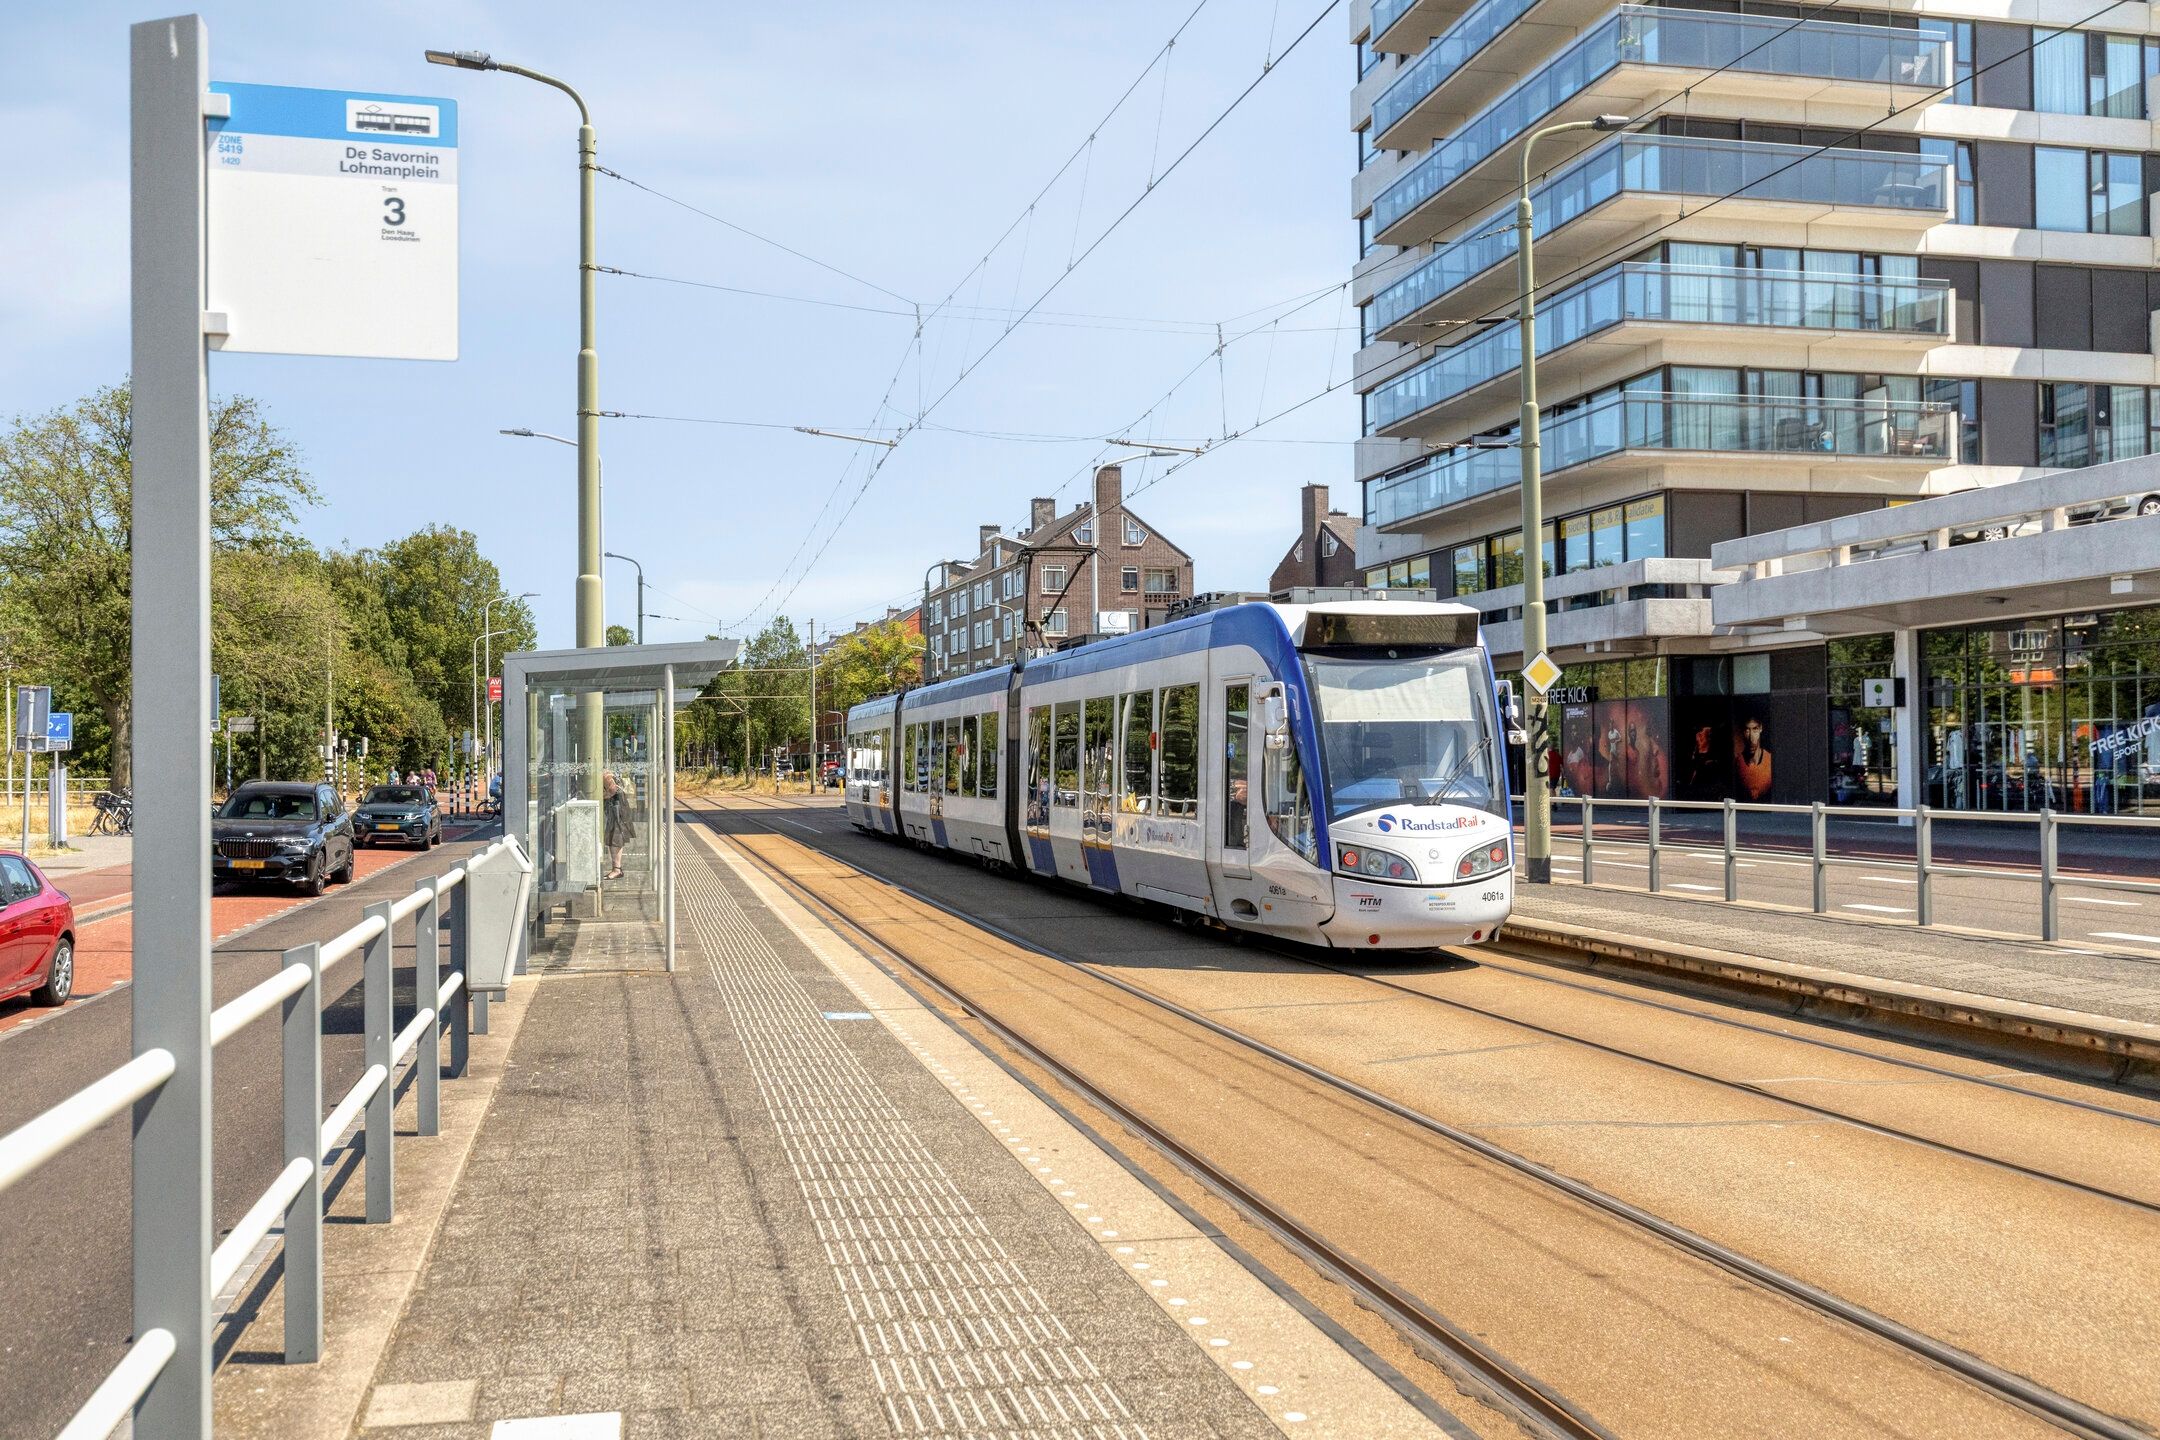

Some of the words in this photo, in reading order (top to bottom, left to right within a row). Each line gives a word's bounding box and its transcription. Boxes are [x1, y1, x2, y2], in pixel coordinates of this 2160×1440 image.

[219, 135, 242, 145] ZONE
[218, 144, 243, 154] 5419
[221, 156, 240, 166] 1420
[346, 147, 367, 160] De
[372, 148, 439, 165] Savornin
[340, 160, 439, 179] Lohmanplein
[383, 197, 406, 226] 3
[396, 229, 415, 237] Haag
[1546, 688, 1567, 704] FREE
[1567, 686, 1588, 703] KICK
[2089, 730, 2126, 757] FREE
[2113, 742, 2142, 761] SPORT
[1401, 815, 1478, 831] RandstadRail
[1268, 885, 1287, 896] 4061a
[1482, 891, 1504, 902] 4061a
[1359, 898, 1382, 906] HTM
